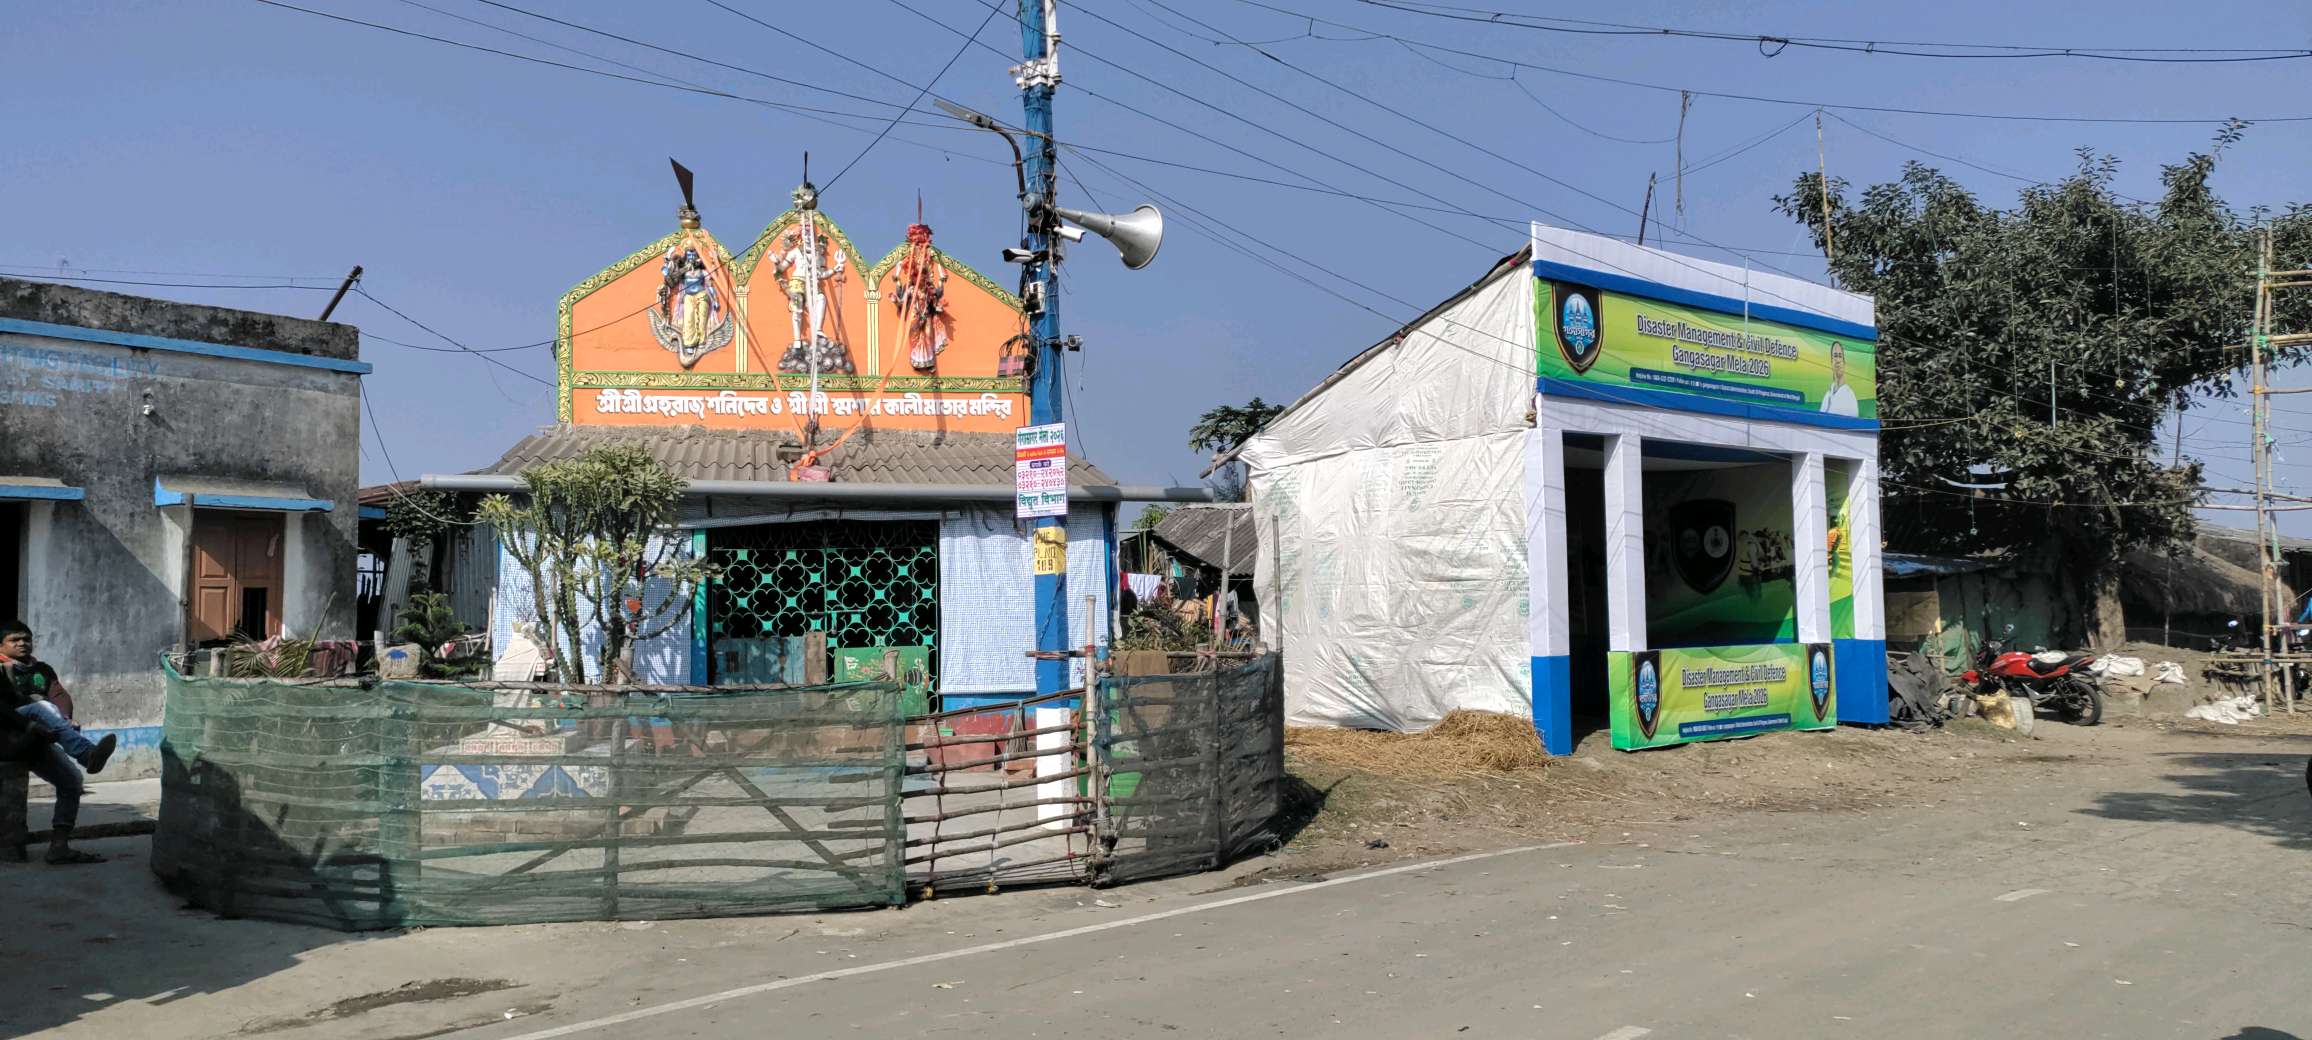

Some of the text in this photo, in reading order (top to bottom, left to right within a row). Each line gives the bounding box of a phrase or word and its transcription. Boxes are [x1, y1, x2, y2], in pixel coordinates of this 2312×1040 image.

[1637, 314, 1798, 360] Disaster Management & Civil Defence
[1672, 345, 1770, 377] Gangasagar Mela 2026
[770, 396, 783, 415] ও
[1041, 491, 1065, 504] विभाग
[1682, 666, 1706, 687] Disaster
[1707, 666, 1745, 688] Management
[1750, 665, 1763, 682] Civil
[1764, 664, 1786, 681] Defence
[1704, 688, 1768, 713] Gangasagar Mela 2026
